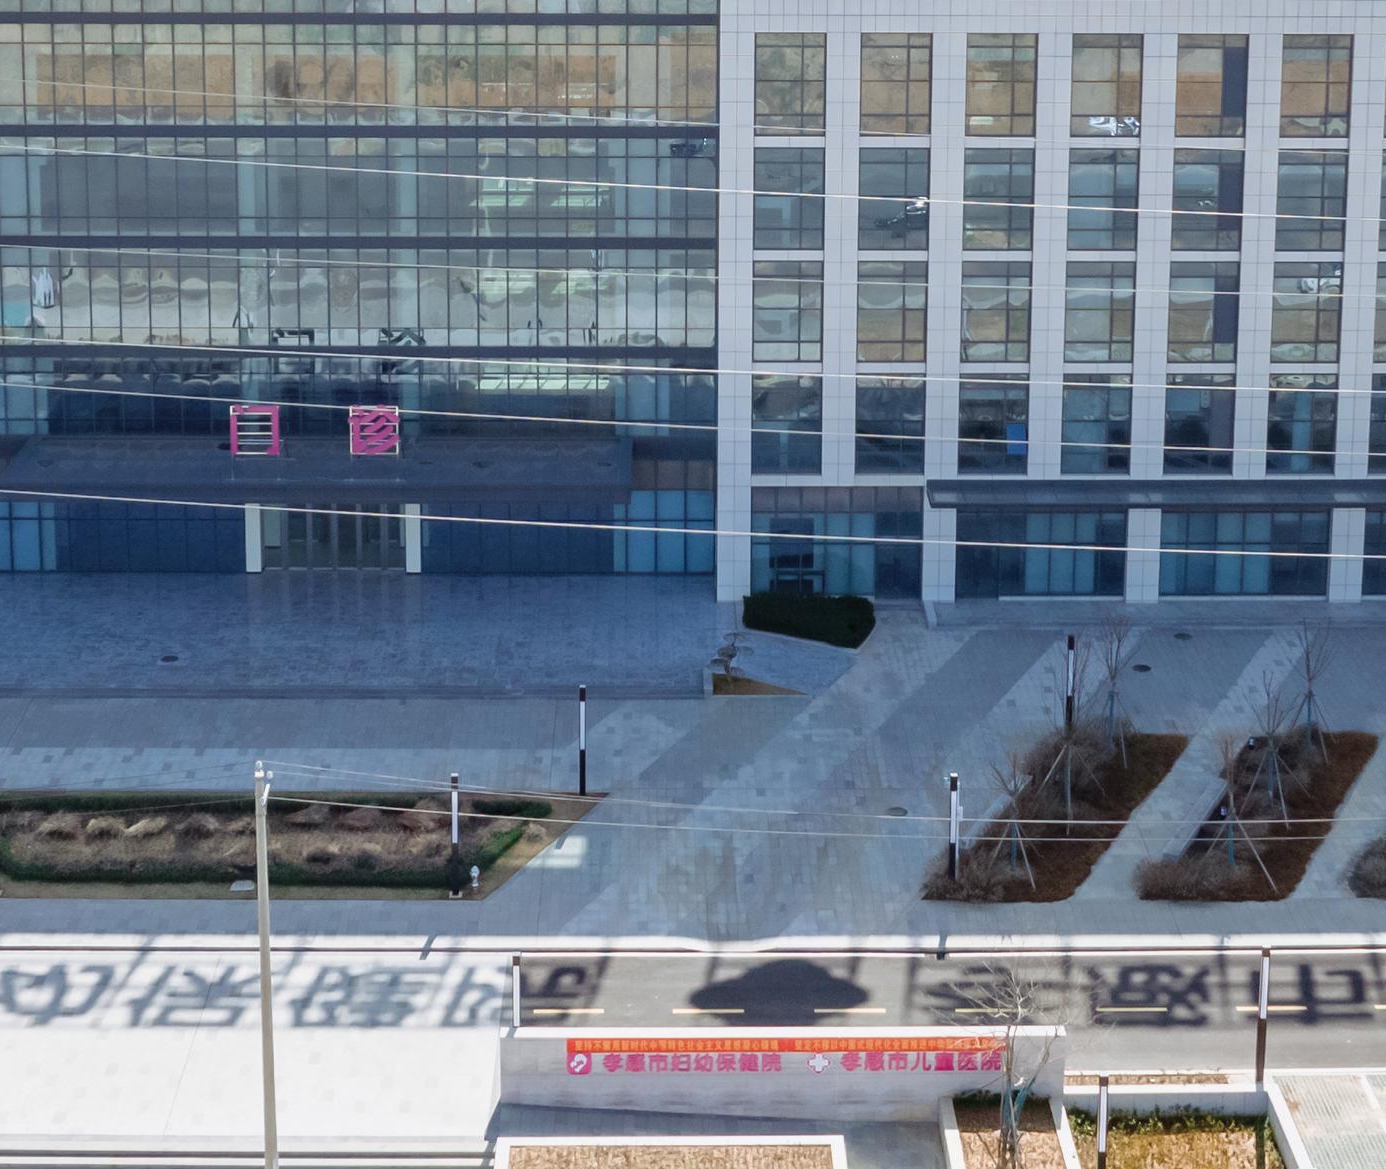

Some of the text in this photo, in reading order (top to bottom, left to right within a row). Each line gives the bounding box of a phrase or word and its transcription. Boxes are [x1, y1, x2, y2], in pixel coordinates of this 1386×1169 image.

[229, 404, 401, 456] 门诊
[602, 1052, 782, 1073] 孝感市妇幼保健院
[840, 1052, 1002, 1072] 孝感市儿童医院
